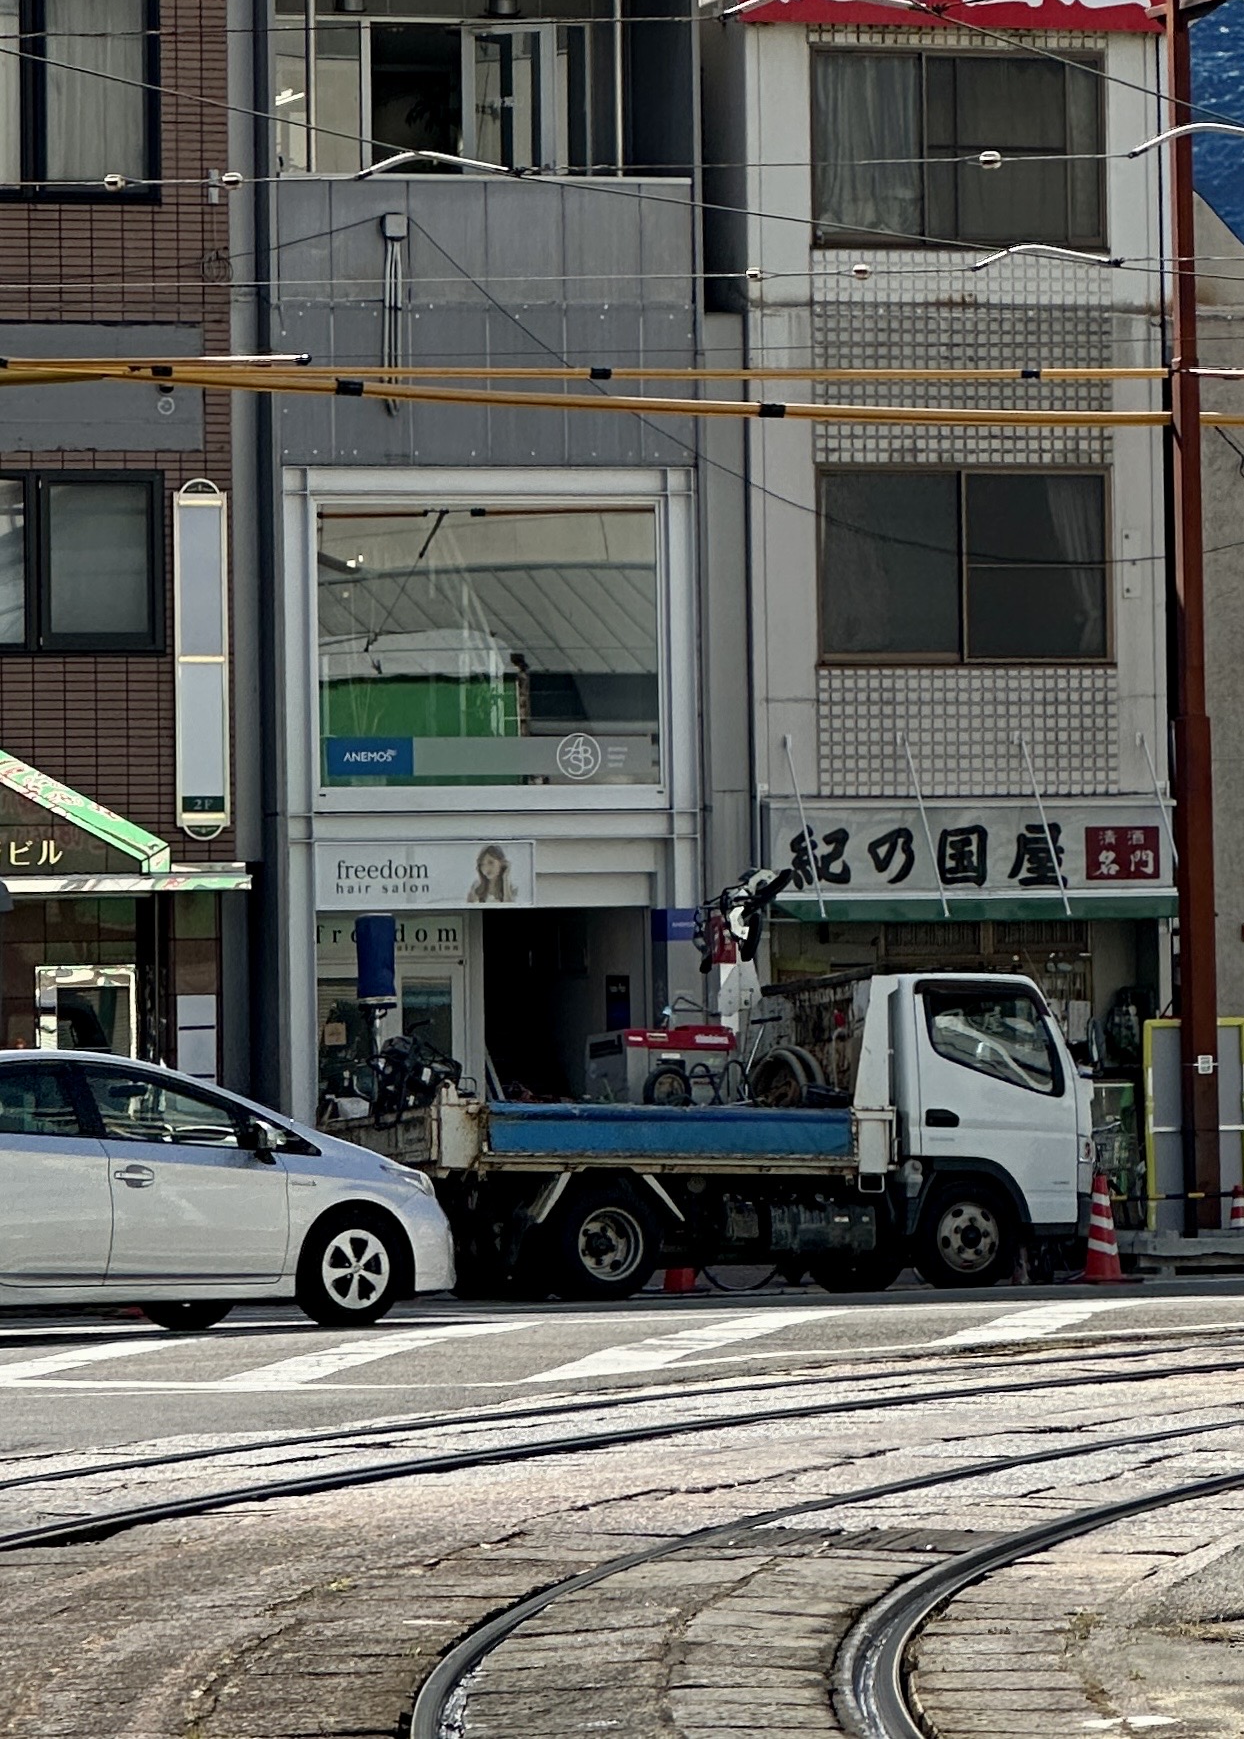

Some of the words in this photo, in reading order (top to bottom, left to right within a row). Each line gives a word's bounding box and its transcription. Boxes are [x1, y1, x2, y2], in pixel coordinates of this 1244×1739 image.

[342, 750, 393, 763] ANEMOS
[1098, 829, 1145, 846] 清酒
[0, 839, 64, 866] ビル
[789, 821, 1068, 890] 紀の国屋
[1092, 849, 1155, 877] 名門
[336, 859, 429, 880] freedom
[336, 882, 372, 895] hair
[381, 881, 431, 894] salon
[316, 924, 458, 945] frdom
